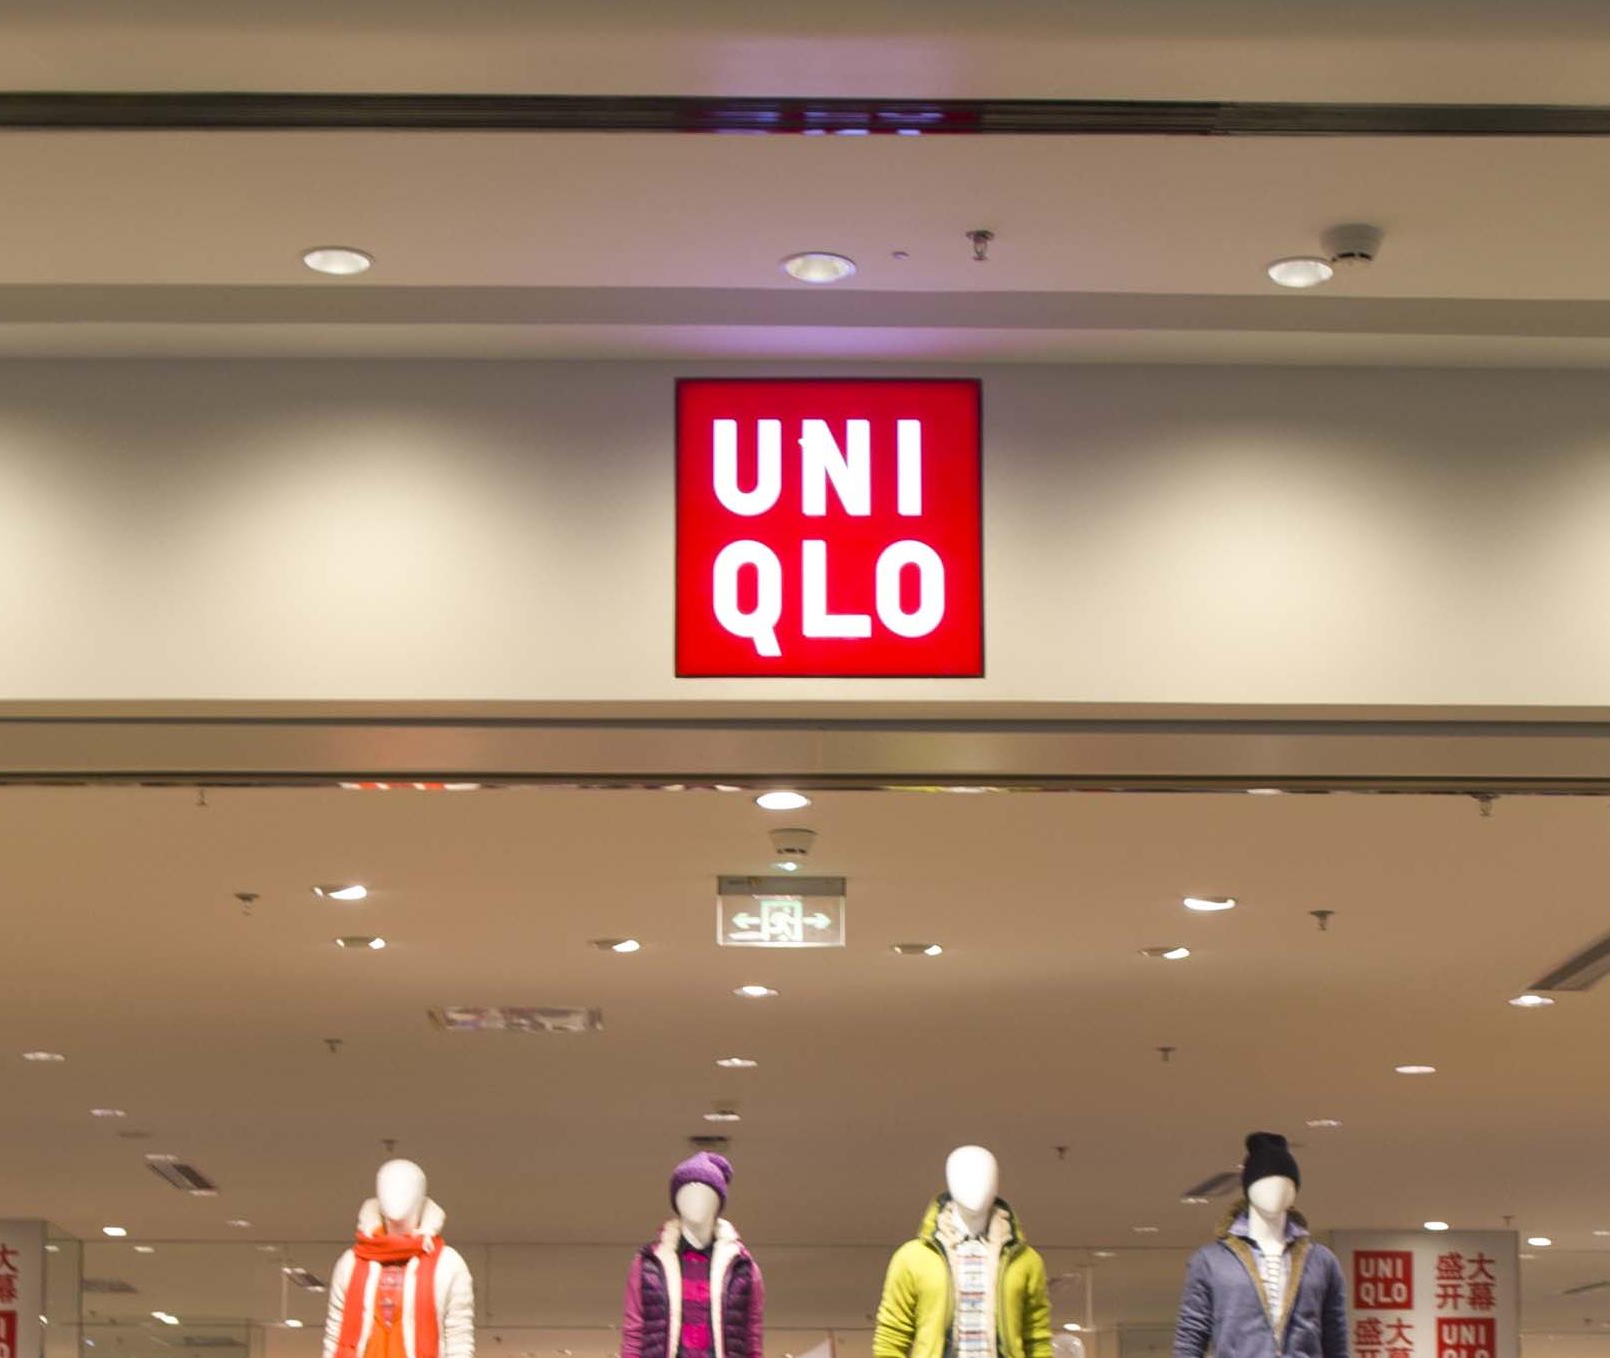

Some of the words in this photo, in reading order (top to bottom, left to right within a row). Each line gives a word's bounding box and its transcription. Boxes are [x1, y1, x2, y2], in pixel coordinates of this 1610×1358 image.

[712, 418, 922, 517] UNI
[712, 538, 946, 657] QLO
[1359, 1257, 1404, 1280] UNI
[1435, 1252, 1496, 1281] 盛大
[1359, 1282, 1408, 1307] QLO
[1435, 1282, 1496, 1310] 开幕
[1353, 1317, 1414, 1346] 盛大
[1442, 1323, 1486, 1345] UNI
